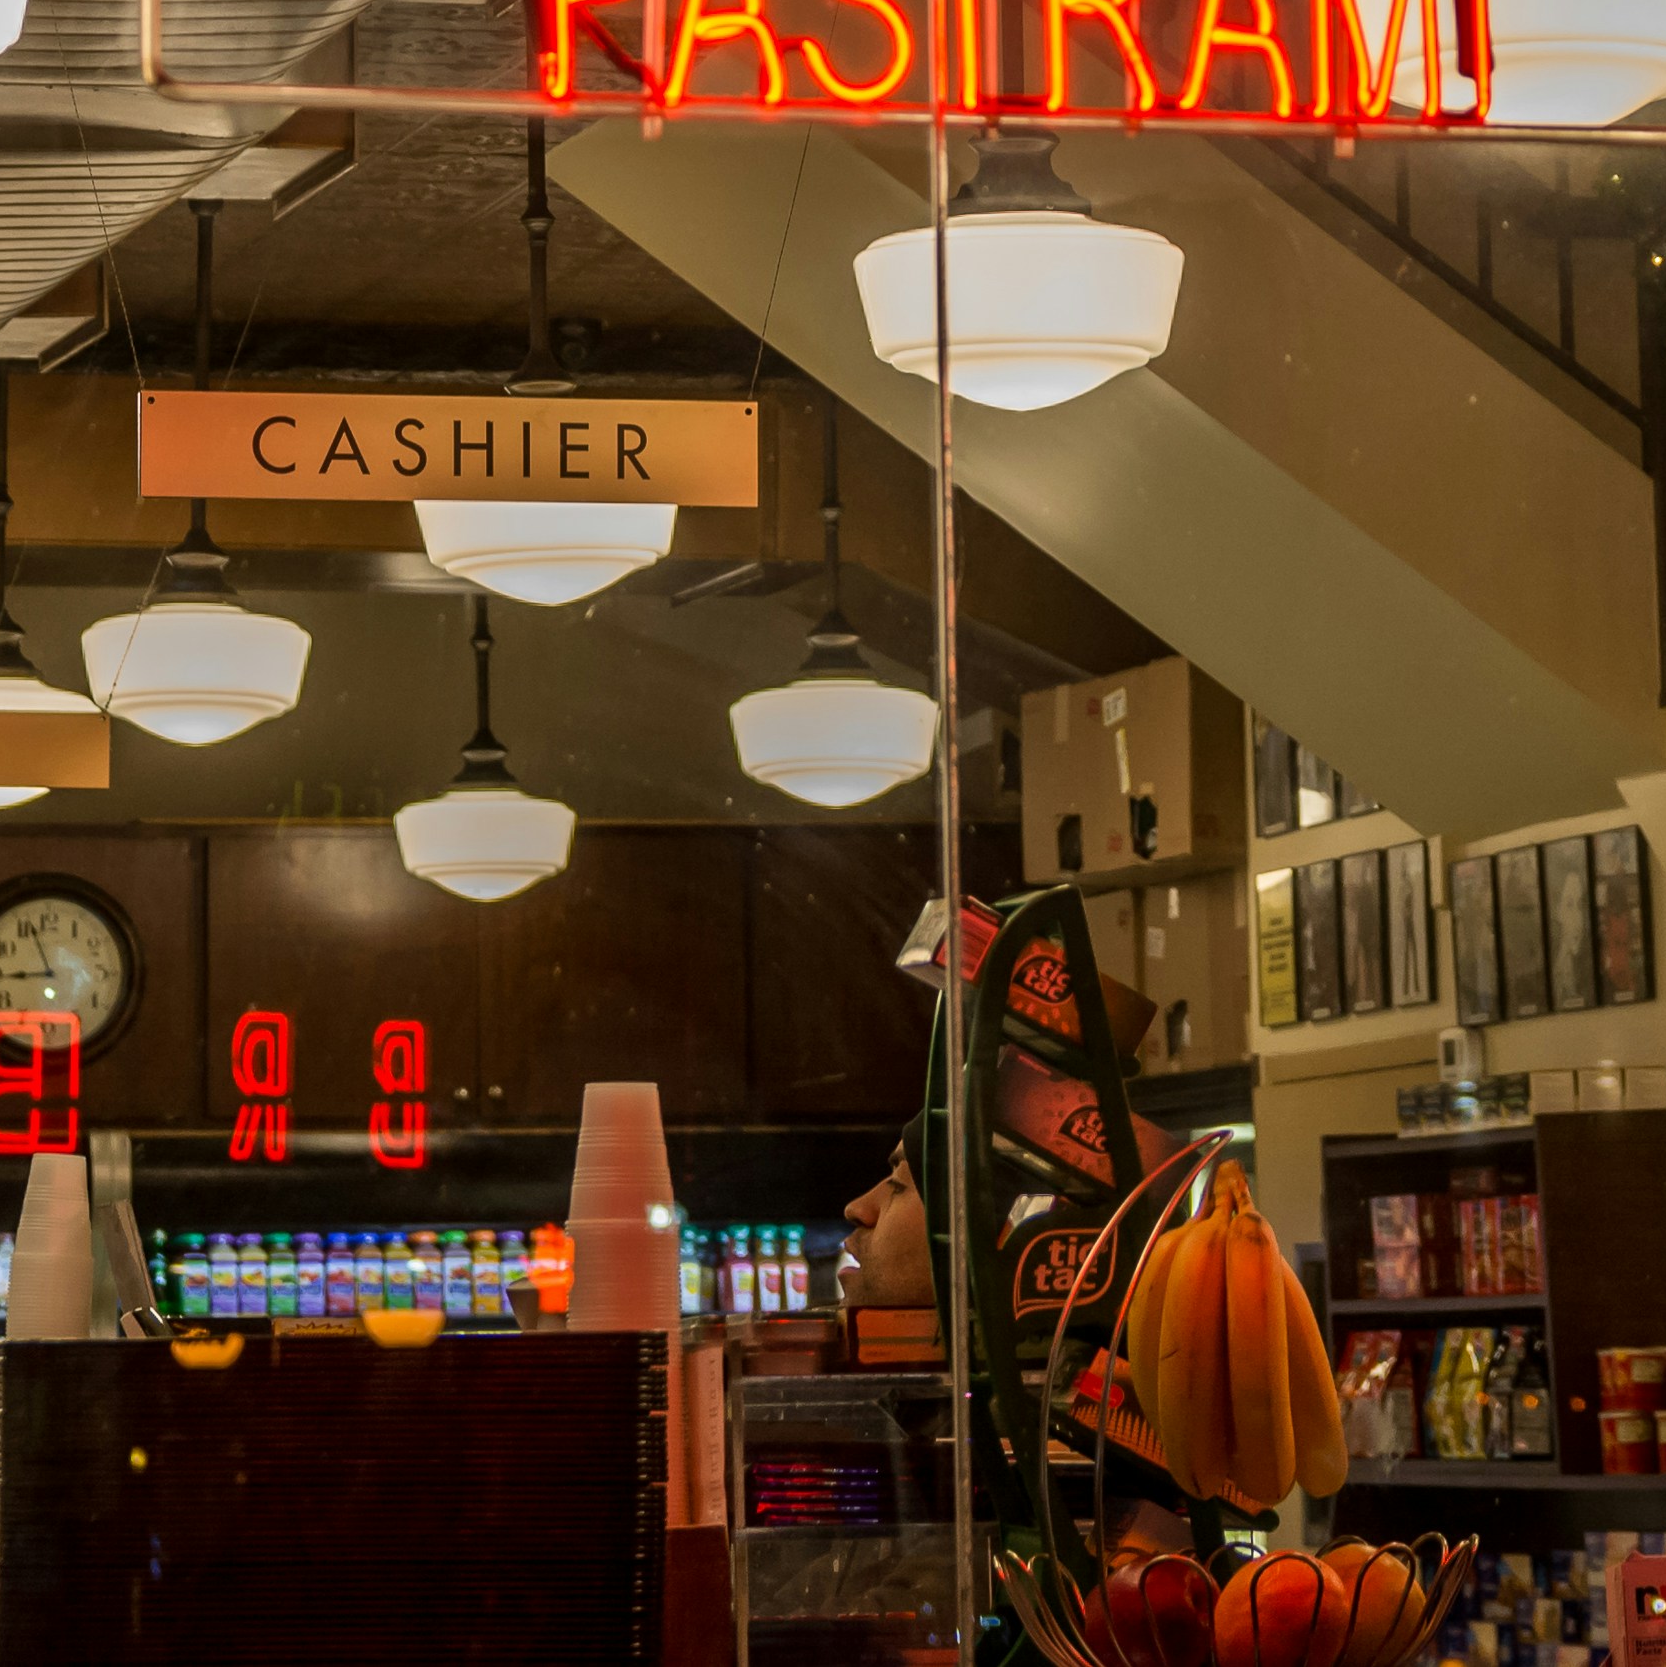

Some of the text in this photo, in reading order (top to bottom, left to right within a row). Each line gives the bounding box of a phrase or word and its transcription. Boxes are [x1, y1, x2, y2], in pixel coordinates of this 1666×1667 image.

[251, 414, 652, 482] CASHIER
[1023, 969, 1066, 1001] tac
[1040, 959, 1071, 988] tic
